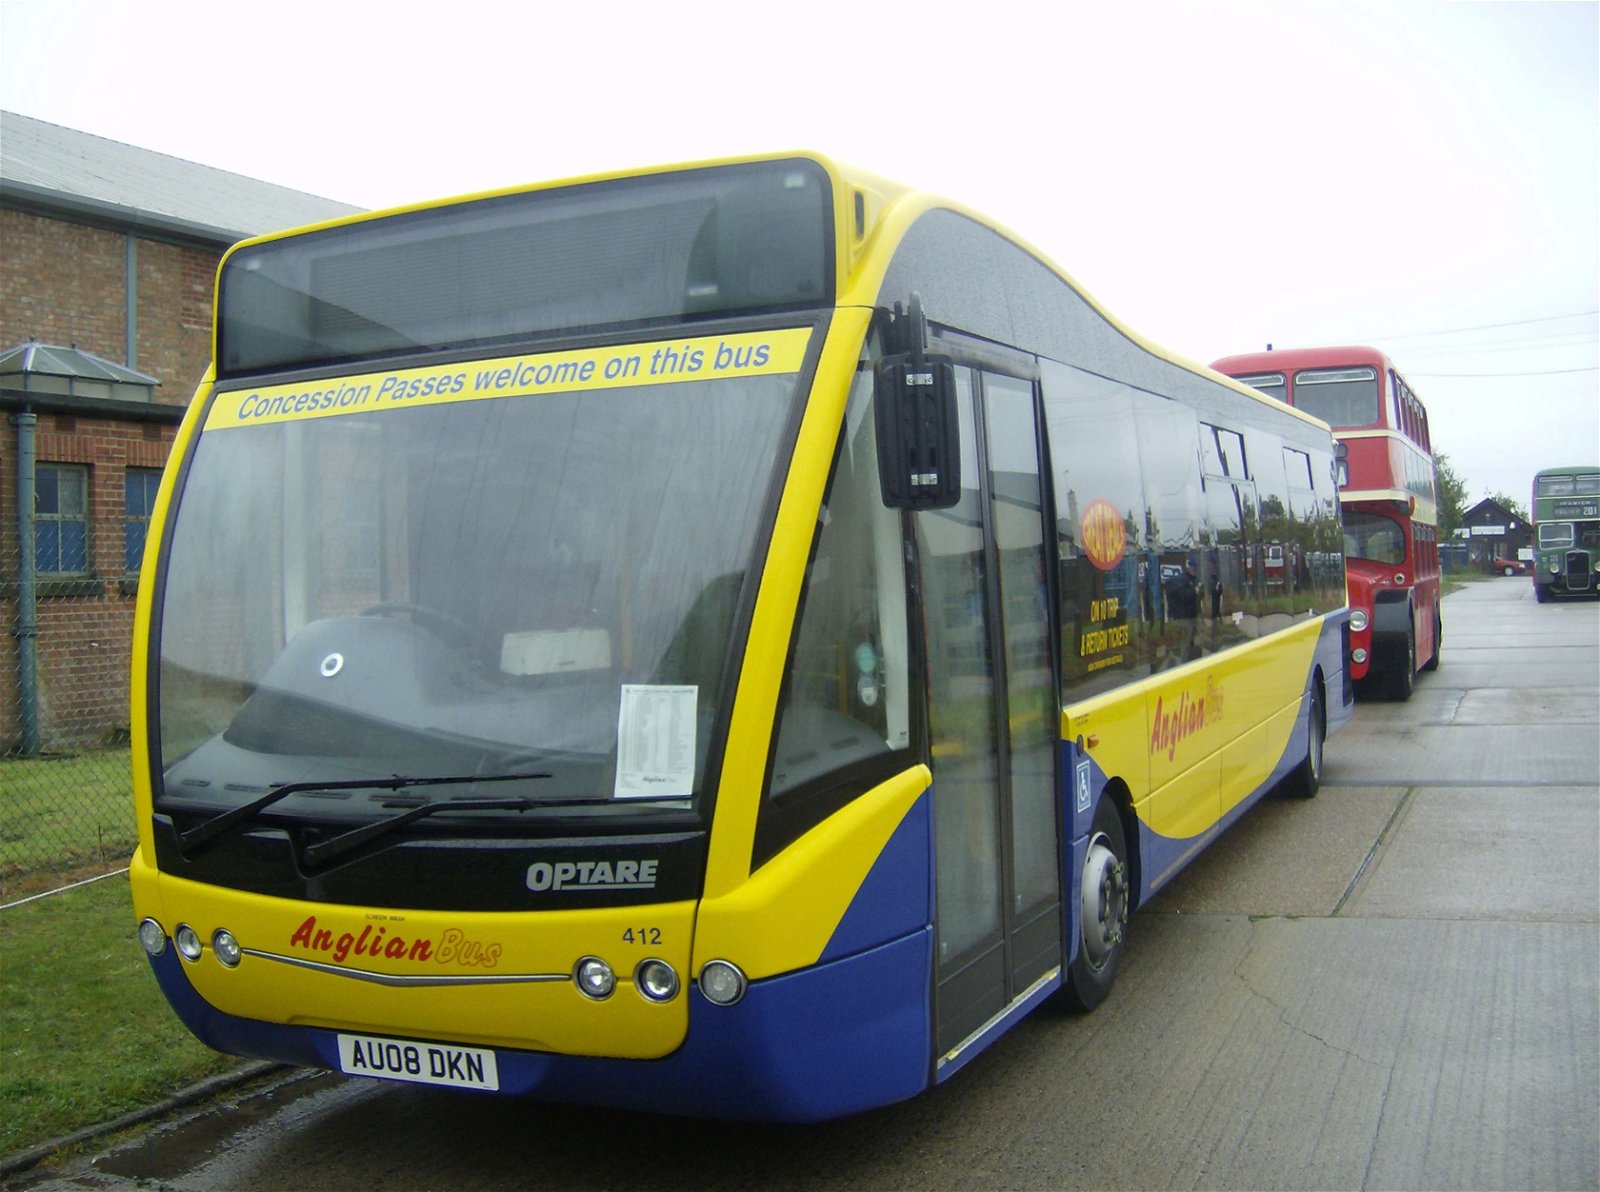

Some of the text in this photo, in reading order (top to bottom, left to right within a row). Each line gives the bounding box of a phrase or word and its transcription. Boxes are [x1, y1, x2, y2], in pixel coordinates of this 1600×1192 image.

[238, 342, 770, 419] Concession Passes welcome on this bus
[1583, 506, 1597, 516] 201
[1086, 630, 1108, 655] RETURN
[1109, 625, 1128, 649] TICKETS
[1151, 687, 1204, 763] Anglian
[526, 860, 658, 891] OPTARE
[290, 916, 502, 968] Anglian Bus
[622, 927, 662, 945] 412
[353, 1040, 484, 1083] AU08 DKN
